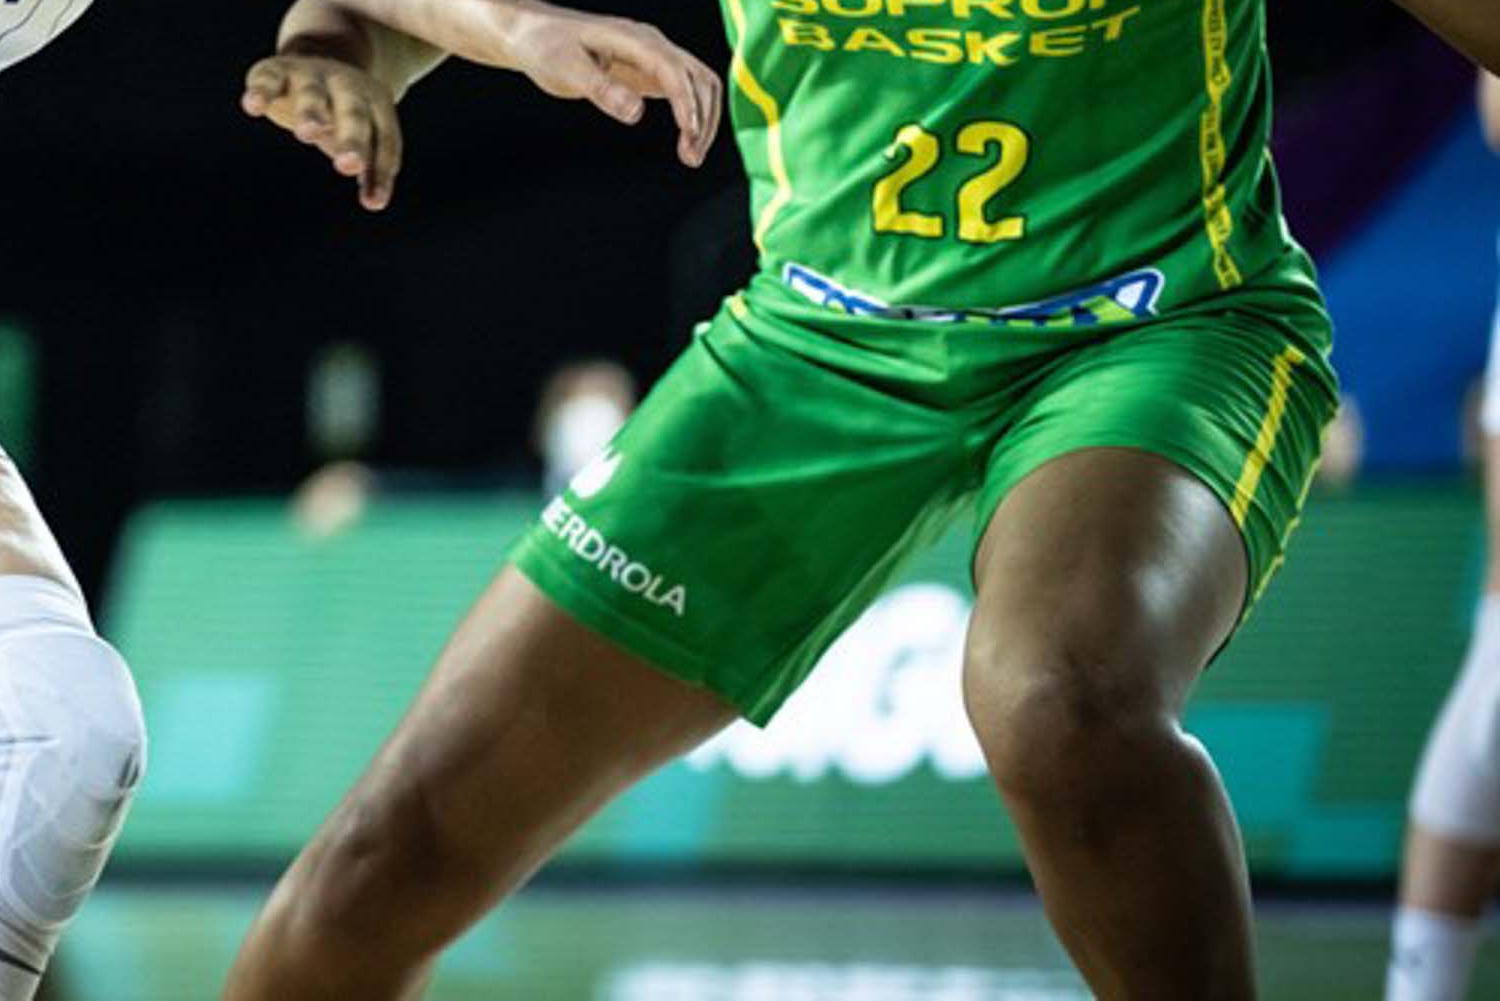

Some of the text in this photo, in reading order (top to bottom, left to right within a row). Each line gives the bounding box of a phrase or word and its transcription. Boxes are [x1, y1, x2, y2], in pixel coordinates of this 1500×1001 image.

[779, 6, 1141, 66] BASKET
[873, 120, 1028, 244] 22
[541, 496, 686, 616] ERDROLA
